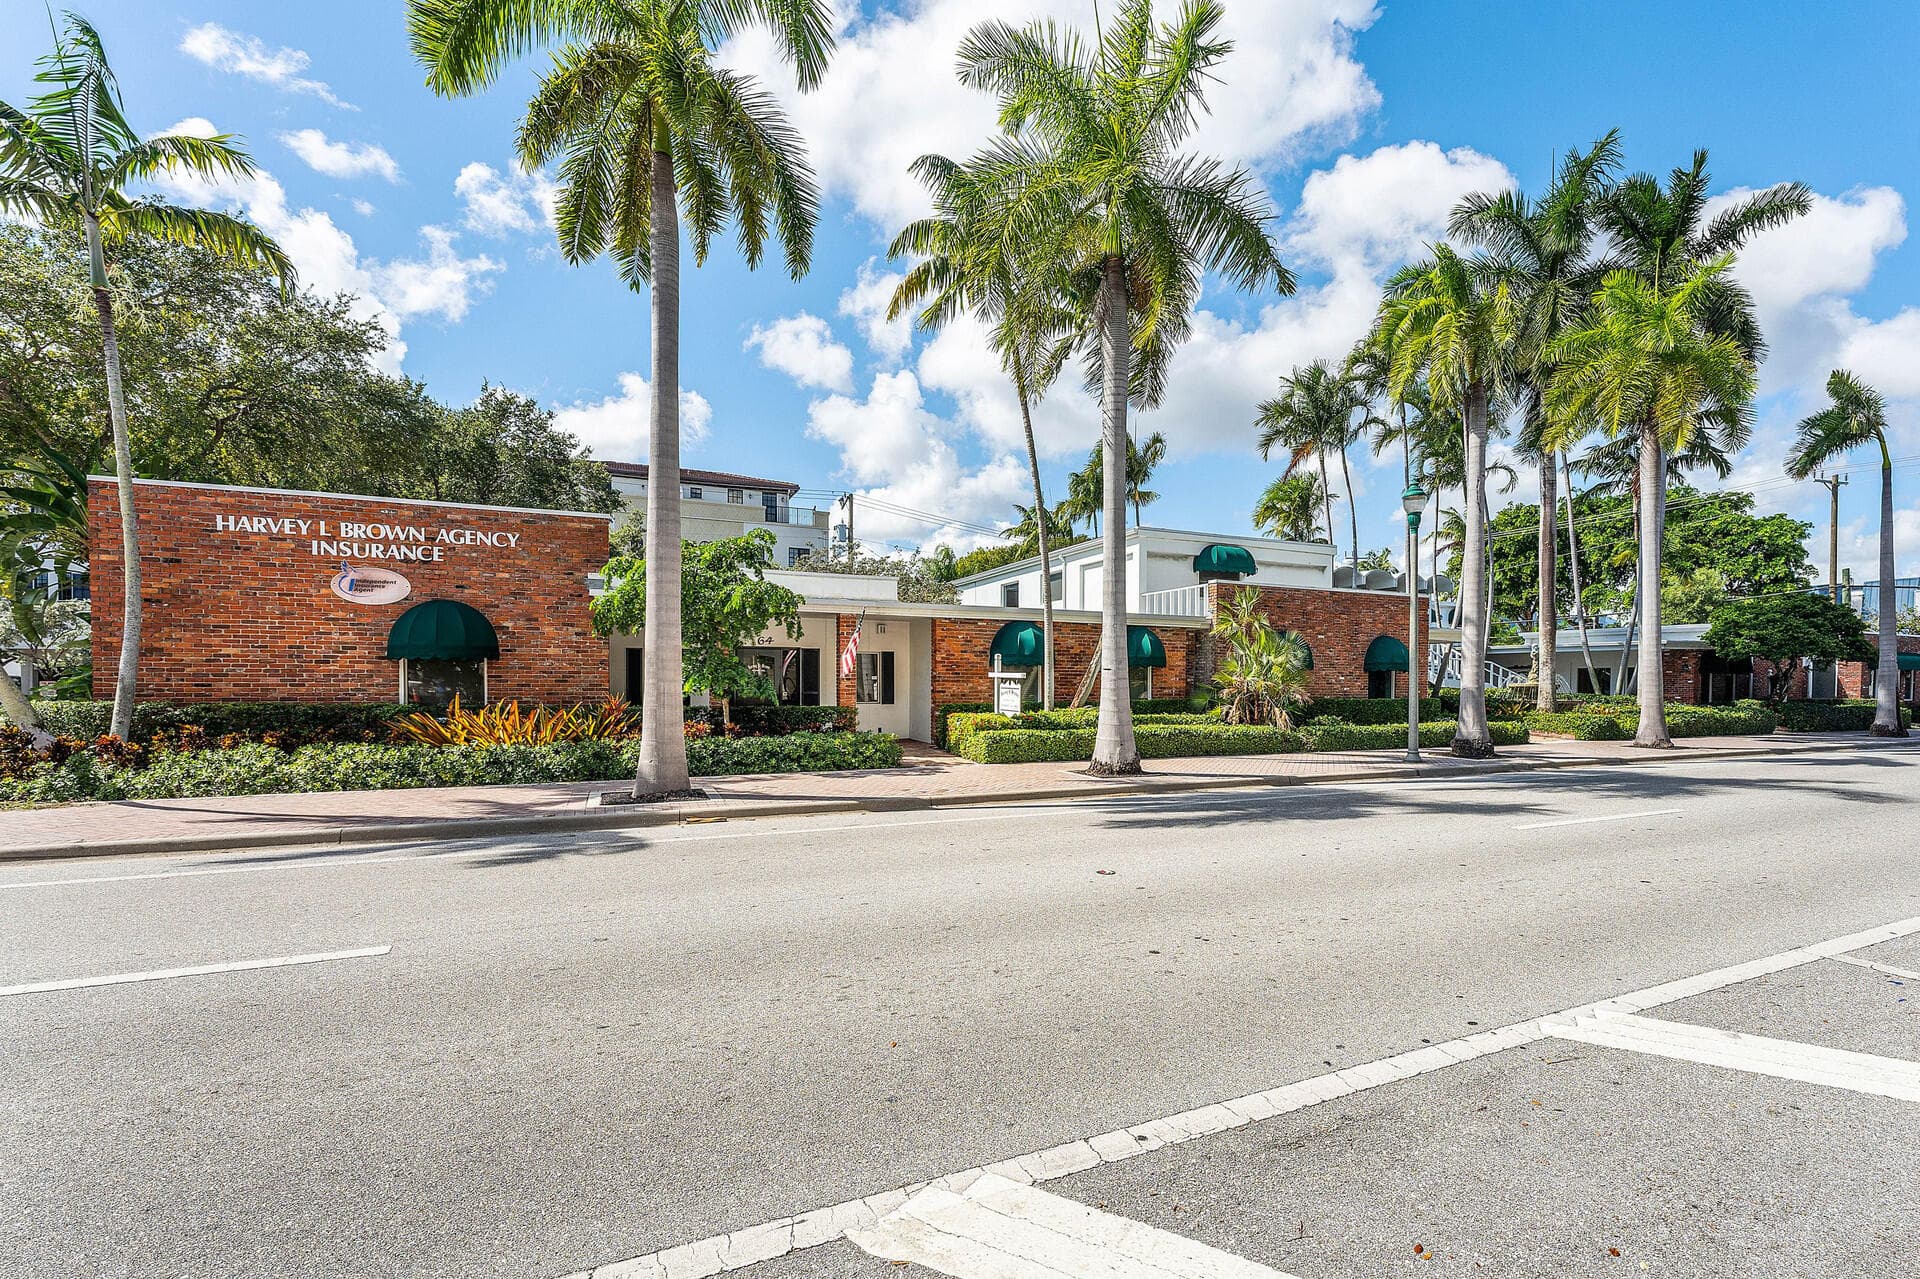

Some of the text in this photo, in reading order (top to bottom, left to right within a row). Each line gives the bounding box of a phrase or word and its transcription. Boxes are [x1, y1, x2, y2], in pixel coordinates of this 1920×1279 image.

[215, 514, 520, 548] HARVEY L BROWN AGENCY
[311, 540, 445, 562] INSURANCE
